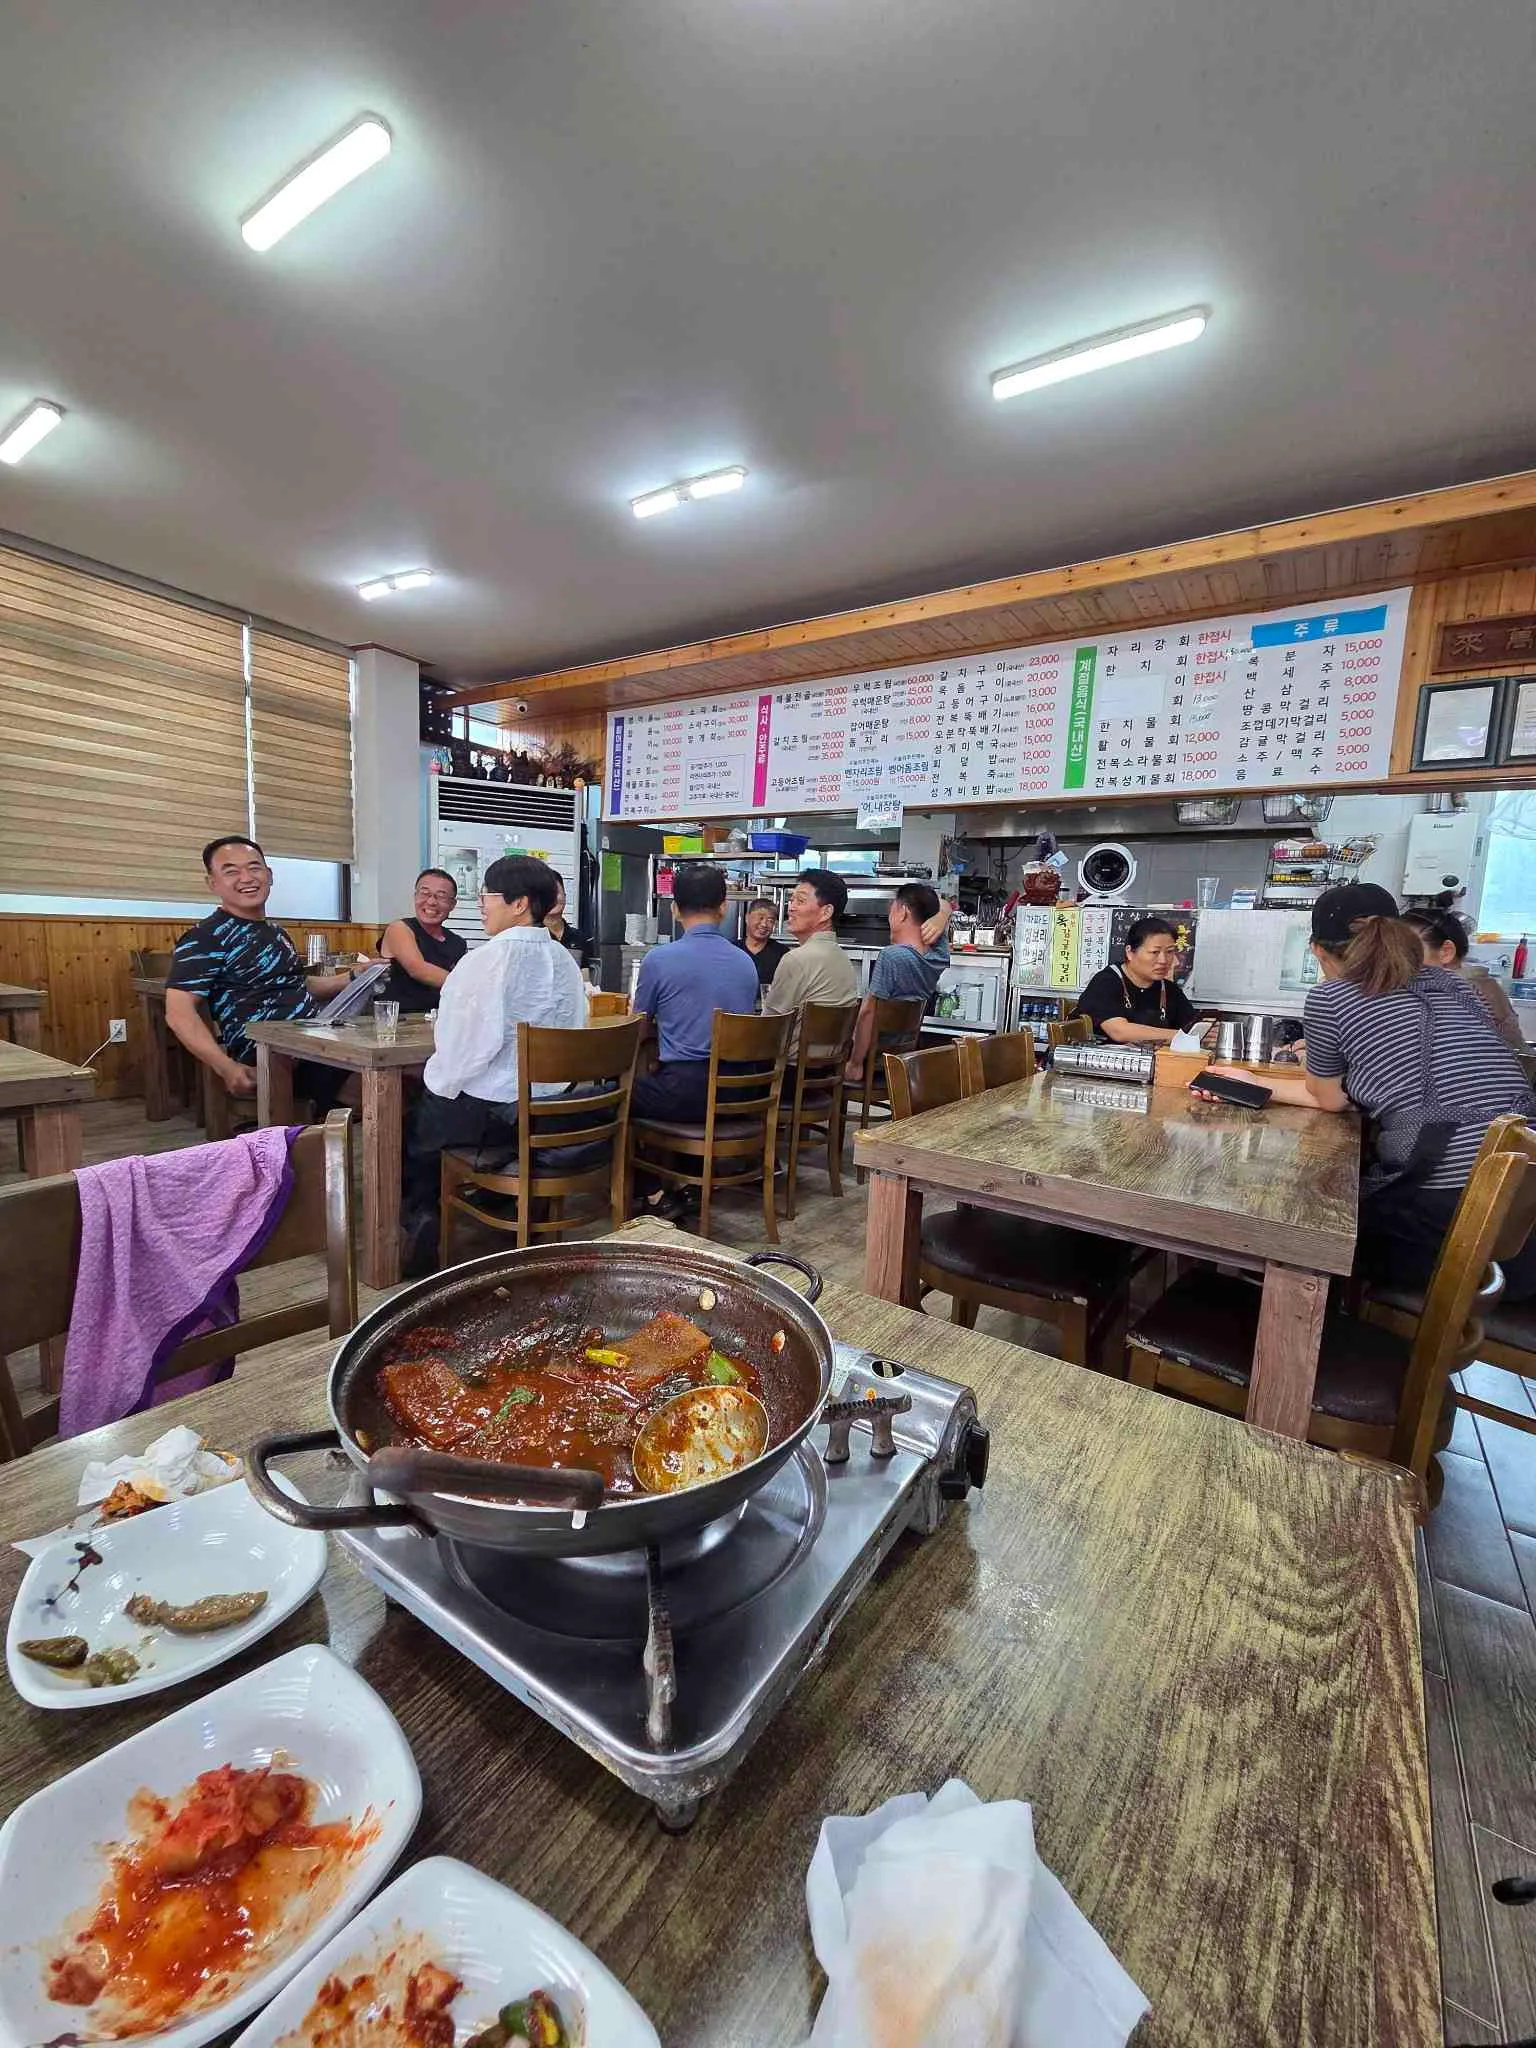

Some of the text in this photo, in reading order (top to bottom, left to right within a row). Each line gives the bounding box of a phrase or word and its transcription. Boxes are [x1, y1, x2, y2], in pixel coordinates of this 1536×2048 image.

[1294, 618, 1339, 638] 주류
[1107, 629, 1232, 656] 자리강회 한접시
[1344, 639, 1383, 653] 15,000
[939, 662, 1006, 682] 갈치구이
[1029, 654, 1060, 666] 23,000
[1105, 655, 1188, 678] 한치회
[1195, 649, 1228, 666] 한접시
[1246, 656, 1381, 682] 백세주 10,000
[852, 679, 893, 694] 우럭조림
[907, 673, 935, 686] 60,000
[939, 677, 1005, 695] 옥돔구이
[1026, 670, 1058, 684] 20,000
[1193, 671, 1227, 686] 한접시
[1244, 674, 1378, 701] 산삼주 8,000
[825, 686, 848, 697] 70,000
[851, 694, 892, 709] 우럭매운탕
[937, 694, 1004, 710] 고등어구이
[1028, 687, 1057, 698] 13,000
[937, 708, 1002, 725] 전복뚝배기
[1026, 702, 1055, 714] 16,000
[1242, 691, 1377, 716] 땅콩막걸리 5,000
[1025, 718, 1054, 730] 13,000
[1100, 714, 1182, 733] 한치물회
[1240, 708, 1374, 731] 조껍데기막걸리 5,000
[821, 730, 845, 741] 70,000
[905, 730, 931, 742] 15,000
[935, 739, 999, 755] 성게미역국
[1024, 734, 1052, 746] 15,000
[1098, 731, 1221, 752] 활어물회 12,000
[1239, 726, 1372, 748] 감귤막걸리 5,000
[821, 741, 844, 751] 55,000
[1337, 744, 1370, 756] 5,000
[933, 754, 998, 769] 회덮밥
[1023, 750, 1051, 761] 12,000
[1096, 751, 1218, 770] 전복소라물회 15,000
[931, 769, 997, 785] 전복죽
[1021, 765, 1050, 777] 15,000
[1095, 769, 1217, 789] 전복성게물회 18,000
[1235, 761, 1368, 781] 음료수 2,000
[930, 783, 995, 799] 성게비빔밥
[1018, 780, 1048, 793] 18,000
